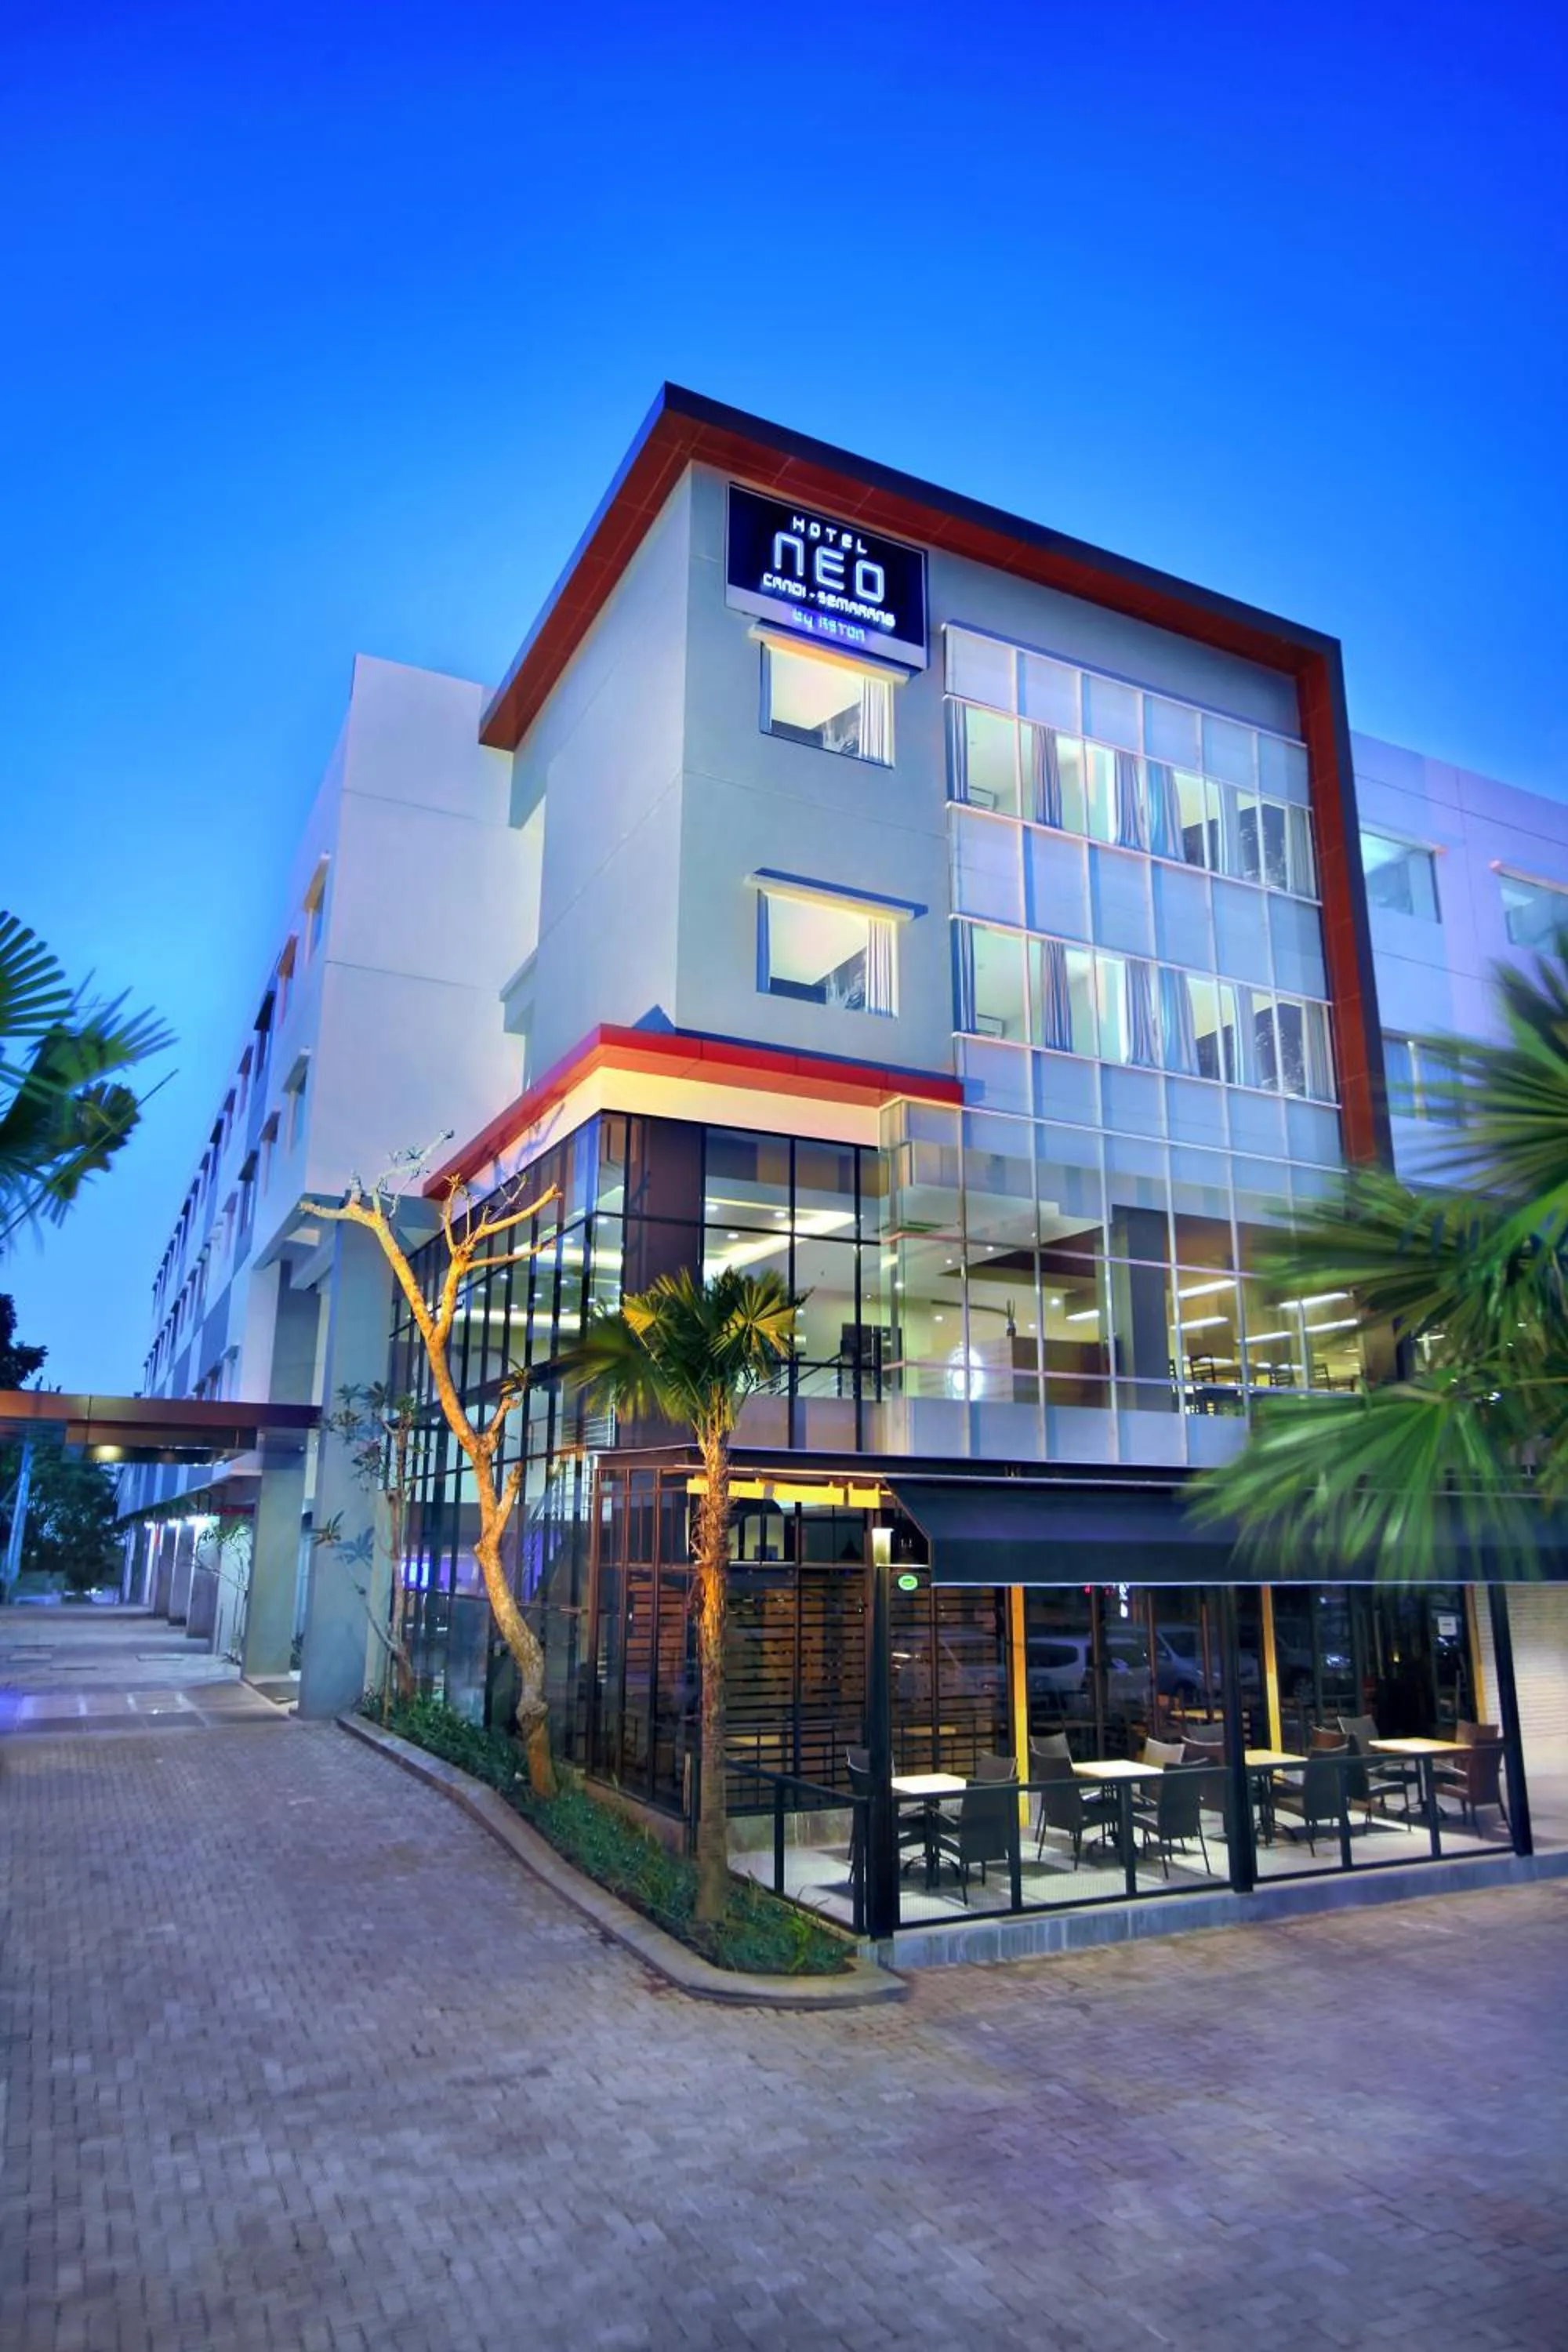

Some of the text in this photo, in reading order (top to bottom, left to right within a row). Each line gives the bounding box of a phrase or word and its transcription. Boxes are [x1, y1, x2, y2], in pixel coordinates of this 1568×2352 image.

[793, 515, 868, 554] HOTEL
[763, 572, 807, 598] CANDI
[817, 590, 896, 627] SEMARANG
